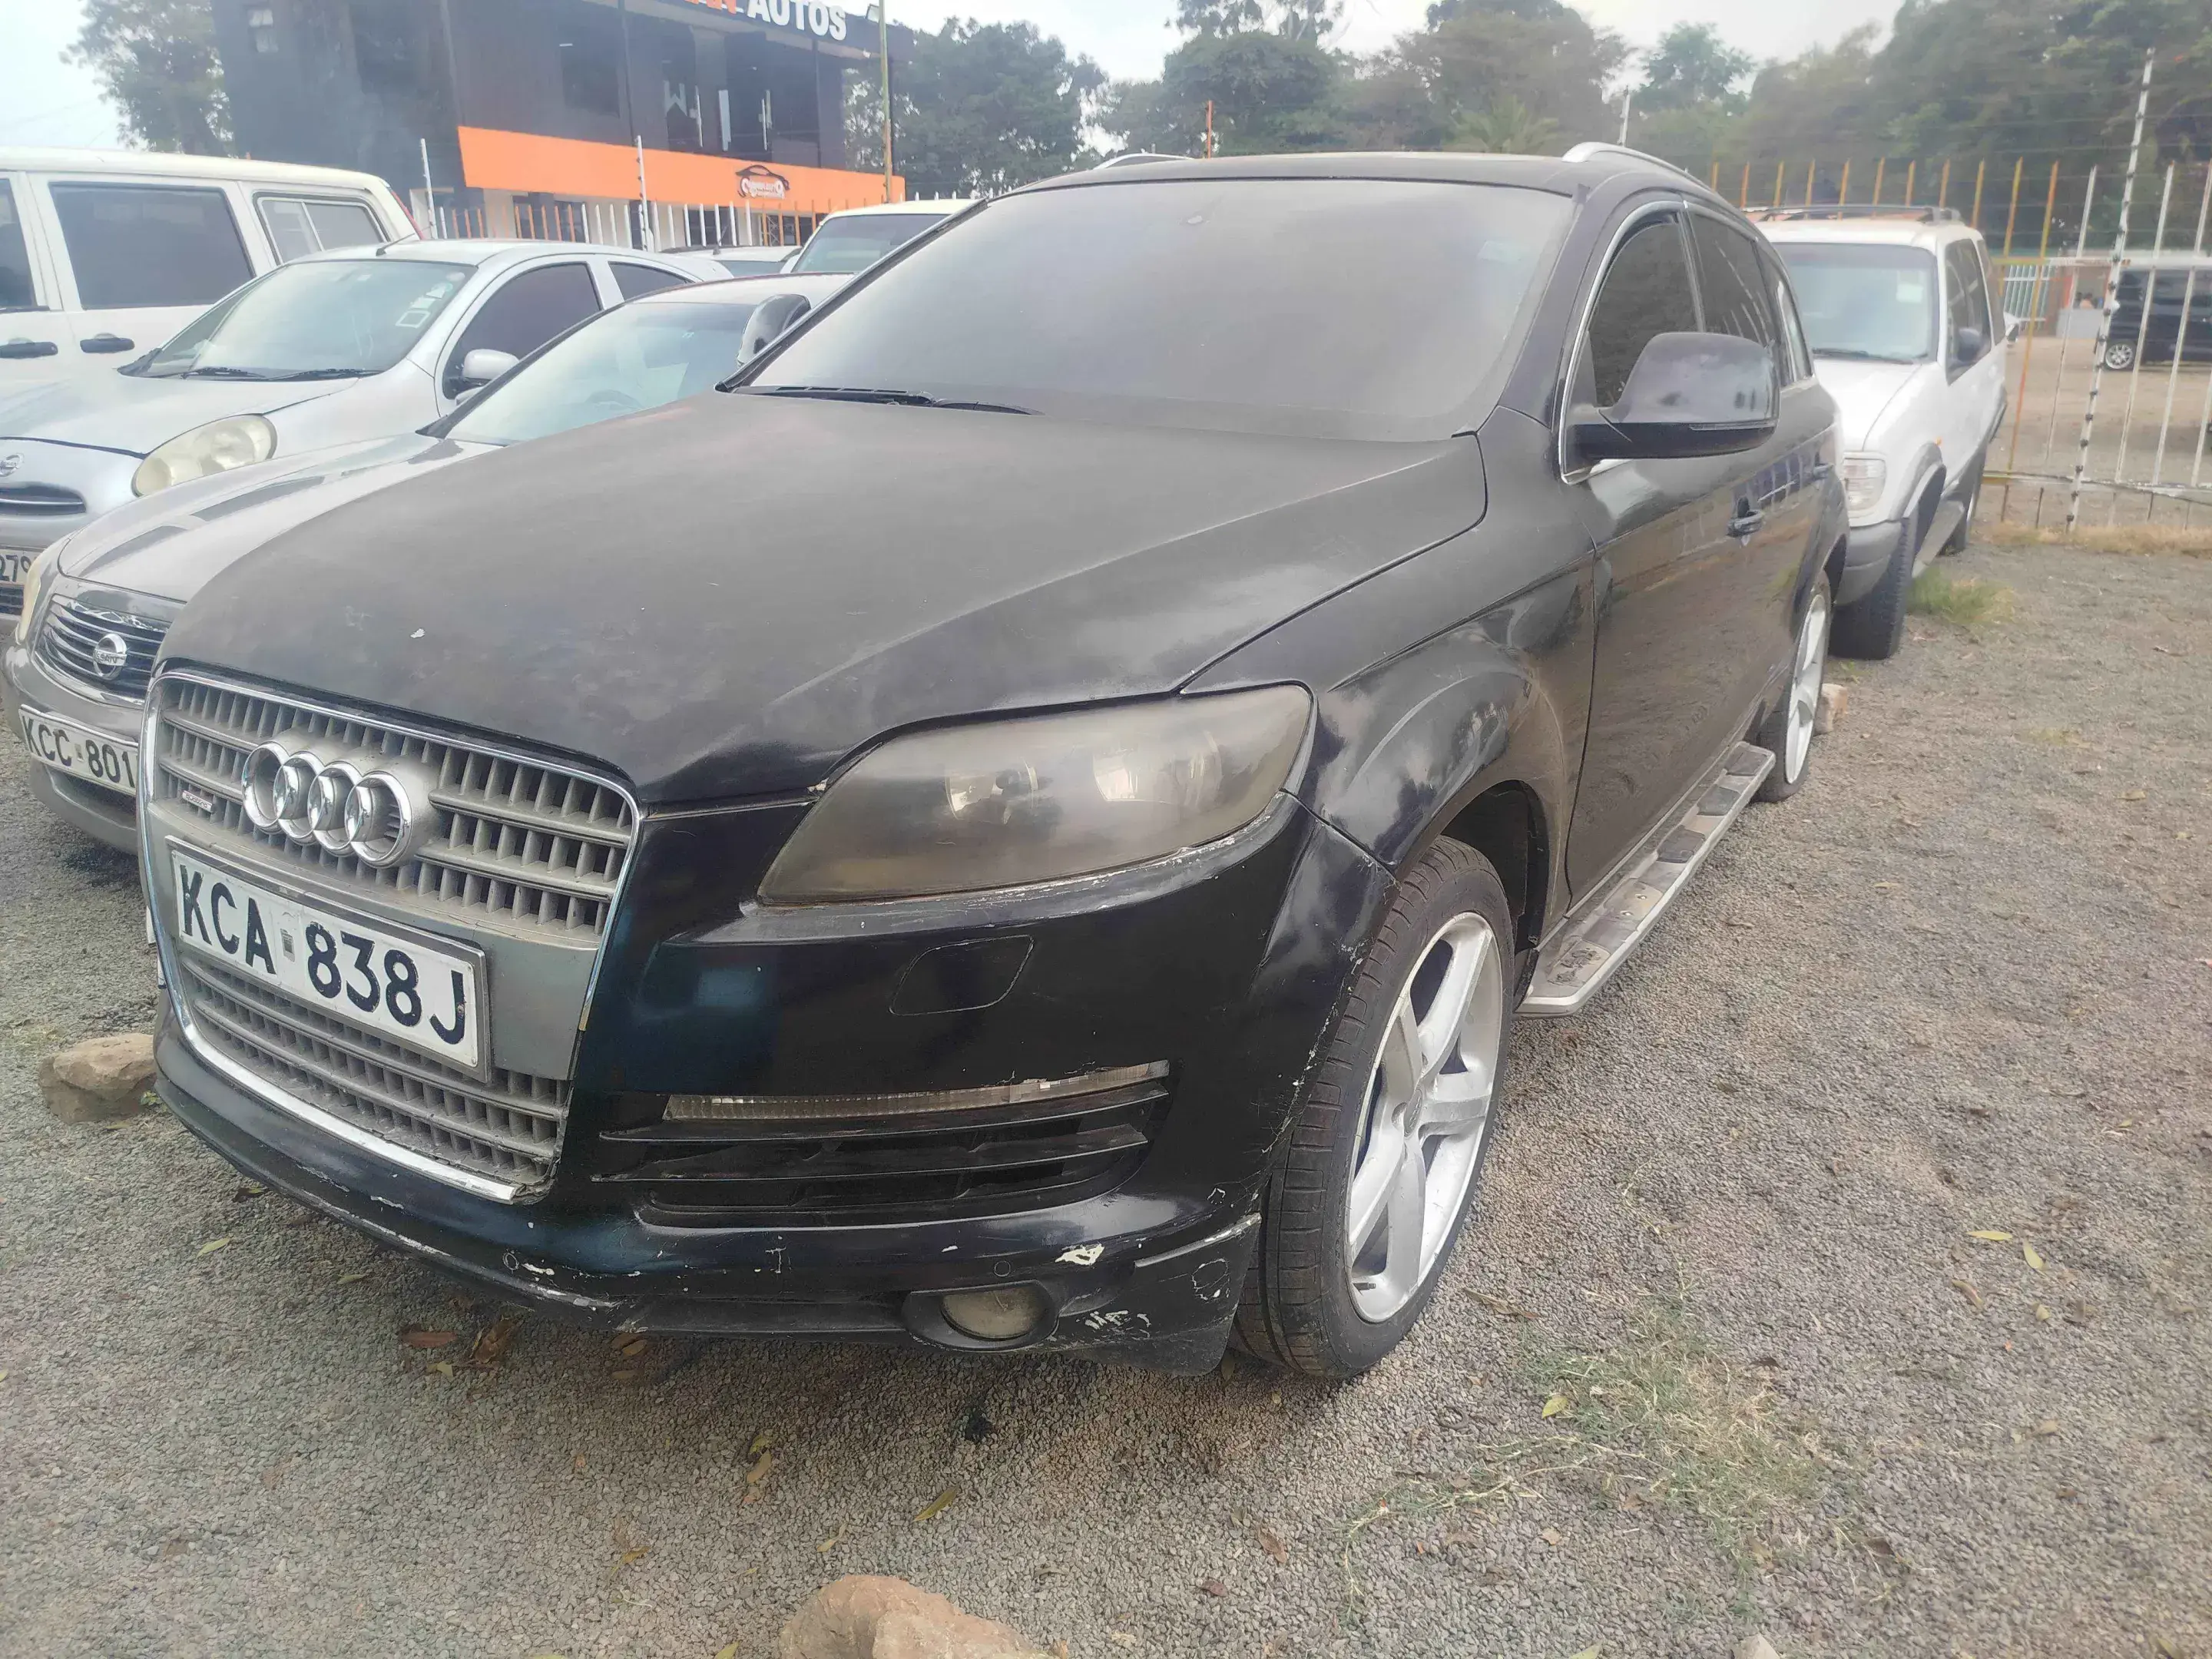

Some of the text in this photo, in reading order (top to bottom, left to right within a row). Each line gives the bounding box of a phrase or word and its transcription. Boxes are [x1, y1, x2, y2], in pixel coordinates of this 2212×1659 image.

[747, 0, 846, 41] AUTOS
[0, 554, 38, 582] 279
[22, 716, 137, 788] KCC 801
[180, 865, 466, 1045] KCA 838J
